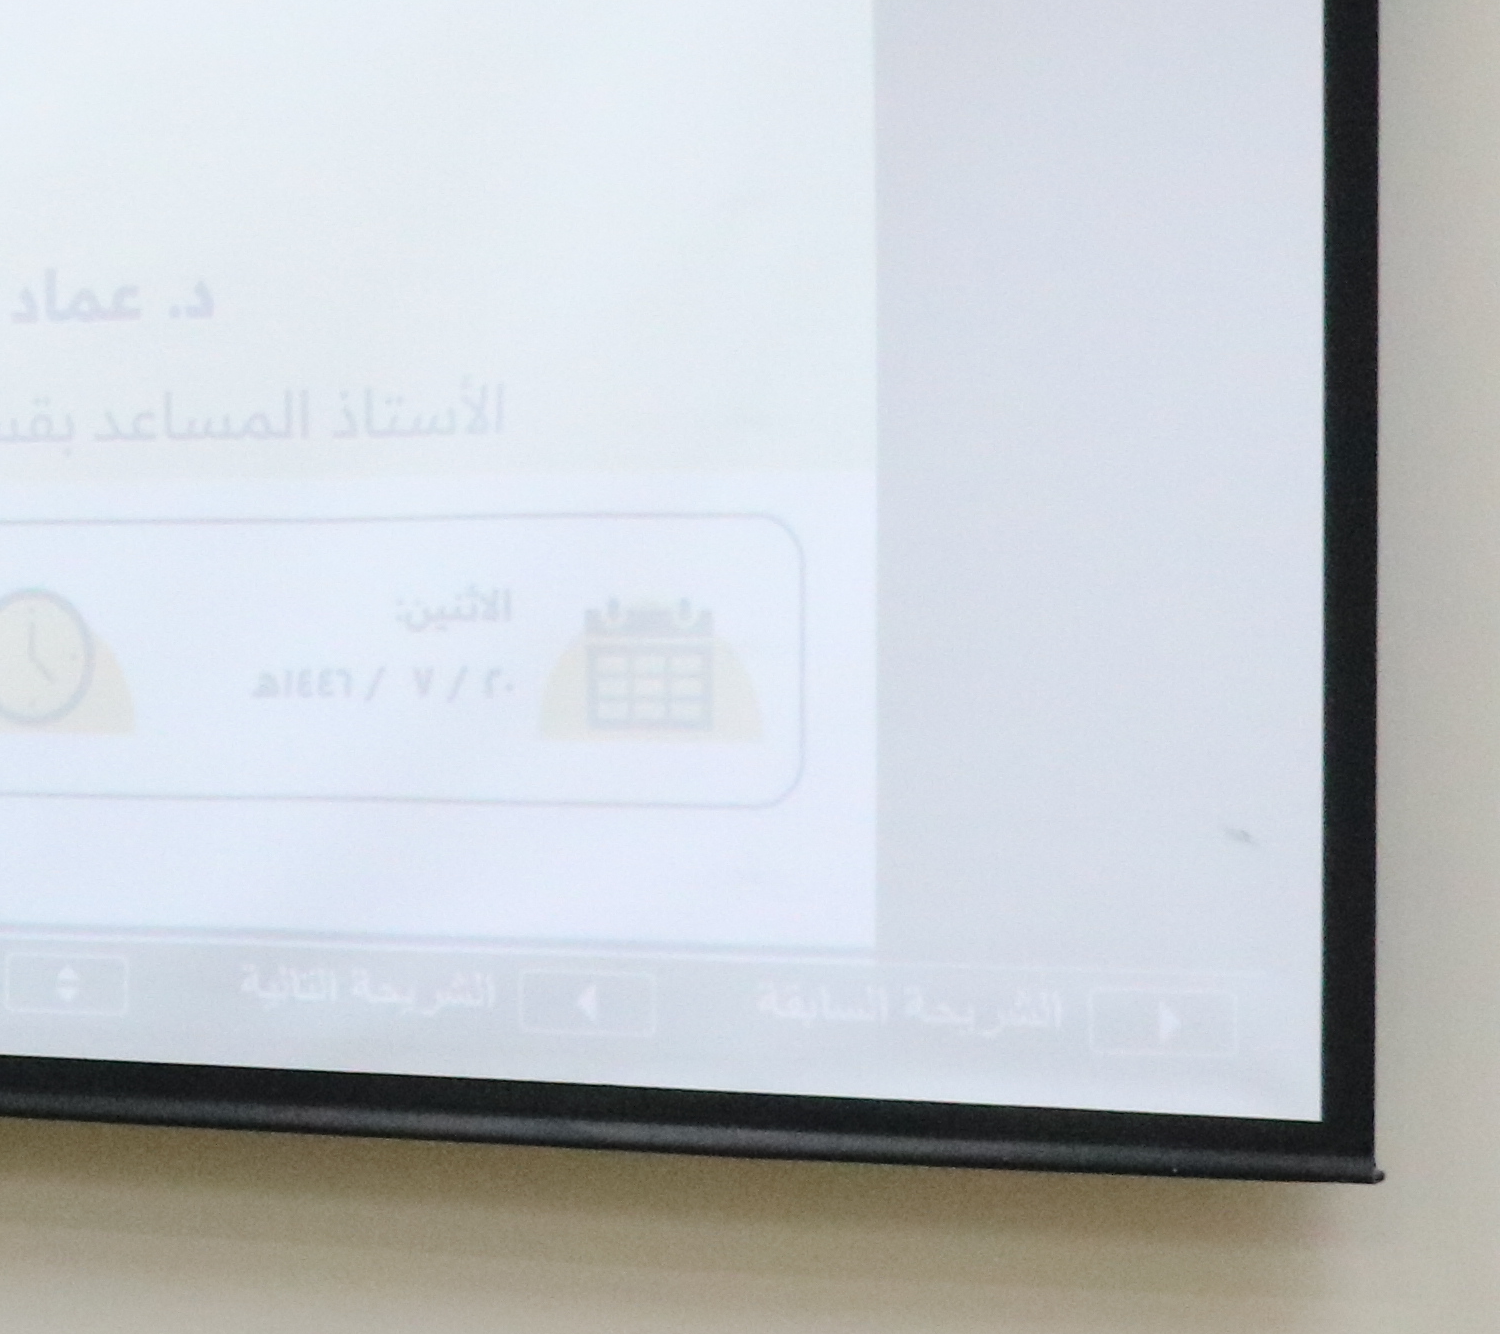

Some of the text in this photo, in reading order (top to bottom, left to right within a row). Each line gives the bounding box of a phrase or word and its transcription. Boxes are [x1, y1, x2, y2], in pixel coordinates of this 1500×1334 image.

[11, 267, 141, 323] عماد
[169, 279, 214, 319] د.
[94, 389, 309, 440] المساعد
[332, 375, 503, 439] الأستاذ
[414, 667, 434, 697] ٧
[240, 964, 496, 1018] الشريحة التالية
[756, 981, 1063, 1039] الشريحة السابقة
